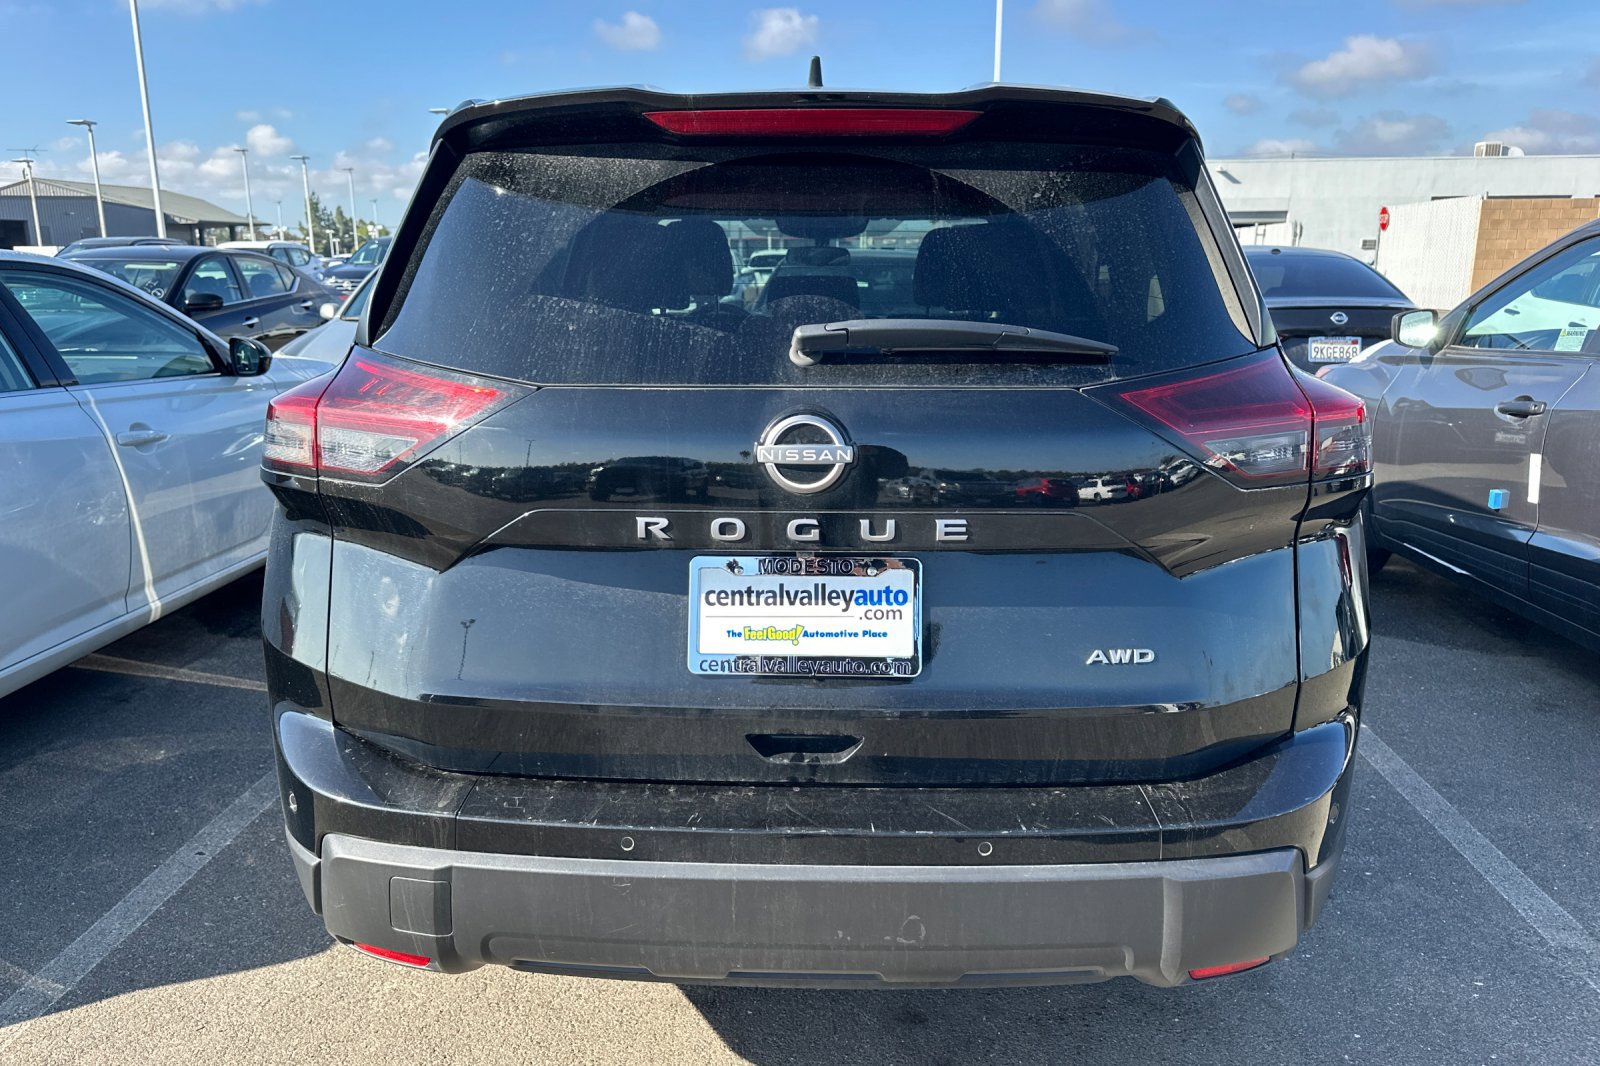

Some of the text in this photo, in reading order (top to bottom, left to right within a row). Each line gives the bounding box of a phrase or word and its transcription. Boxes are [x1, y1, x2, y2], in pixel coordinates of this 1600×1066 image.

[1313, 346, 1358, 359] 9KGE868
[760, 448, 850, 461] NISSAN
[636, 517, 968, 541] ROGUE
[758, 558, 853, 574] MODESTO
[704, 583, 908, 612] centralvalleyauto
[858, 608, 903, 621] .com
[726, 630, 742, 638] The
[802, 630, 859, 638] Automotive
[862, 630, 888, 638] Place
[1085, 648, 1155, 665] AWD
[700, 656, 911, 675] centralvalleyauto.com
